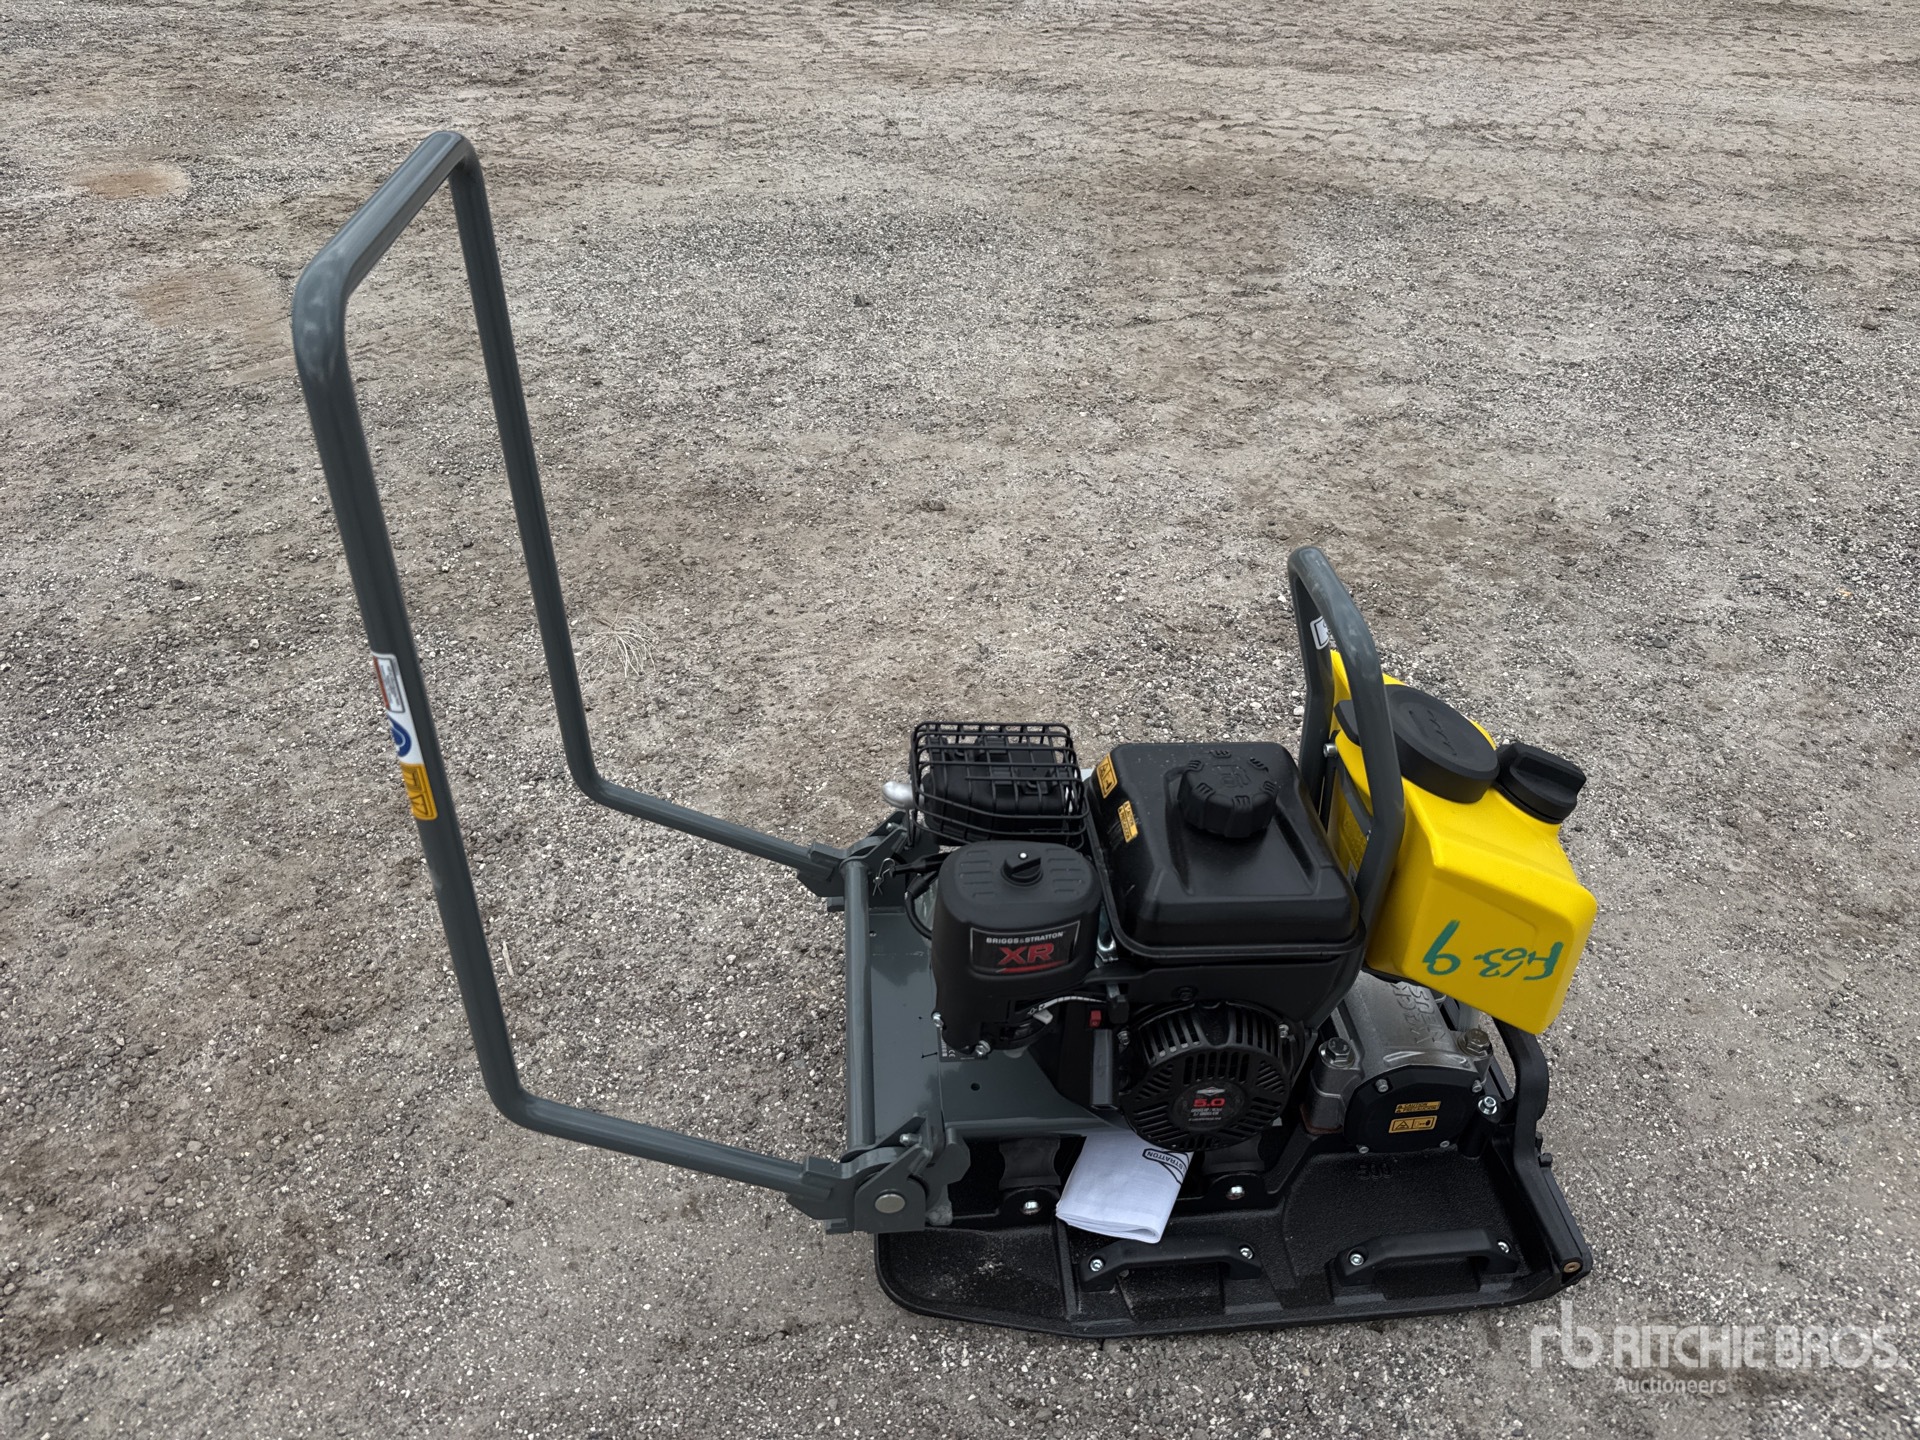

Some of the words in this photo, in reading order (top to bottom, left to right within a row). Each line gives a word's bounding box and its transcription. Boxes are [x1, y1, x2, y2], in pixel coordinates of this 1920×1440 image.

[997, 943, 1055, 966] XR
[1193, 1098, 1226, 1107] 5.0
[1146, 1151, 1184, 1170] STRATTON
